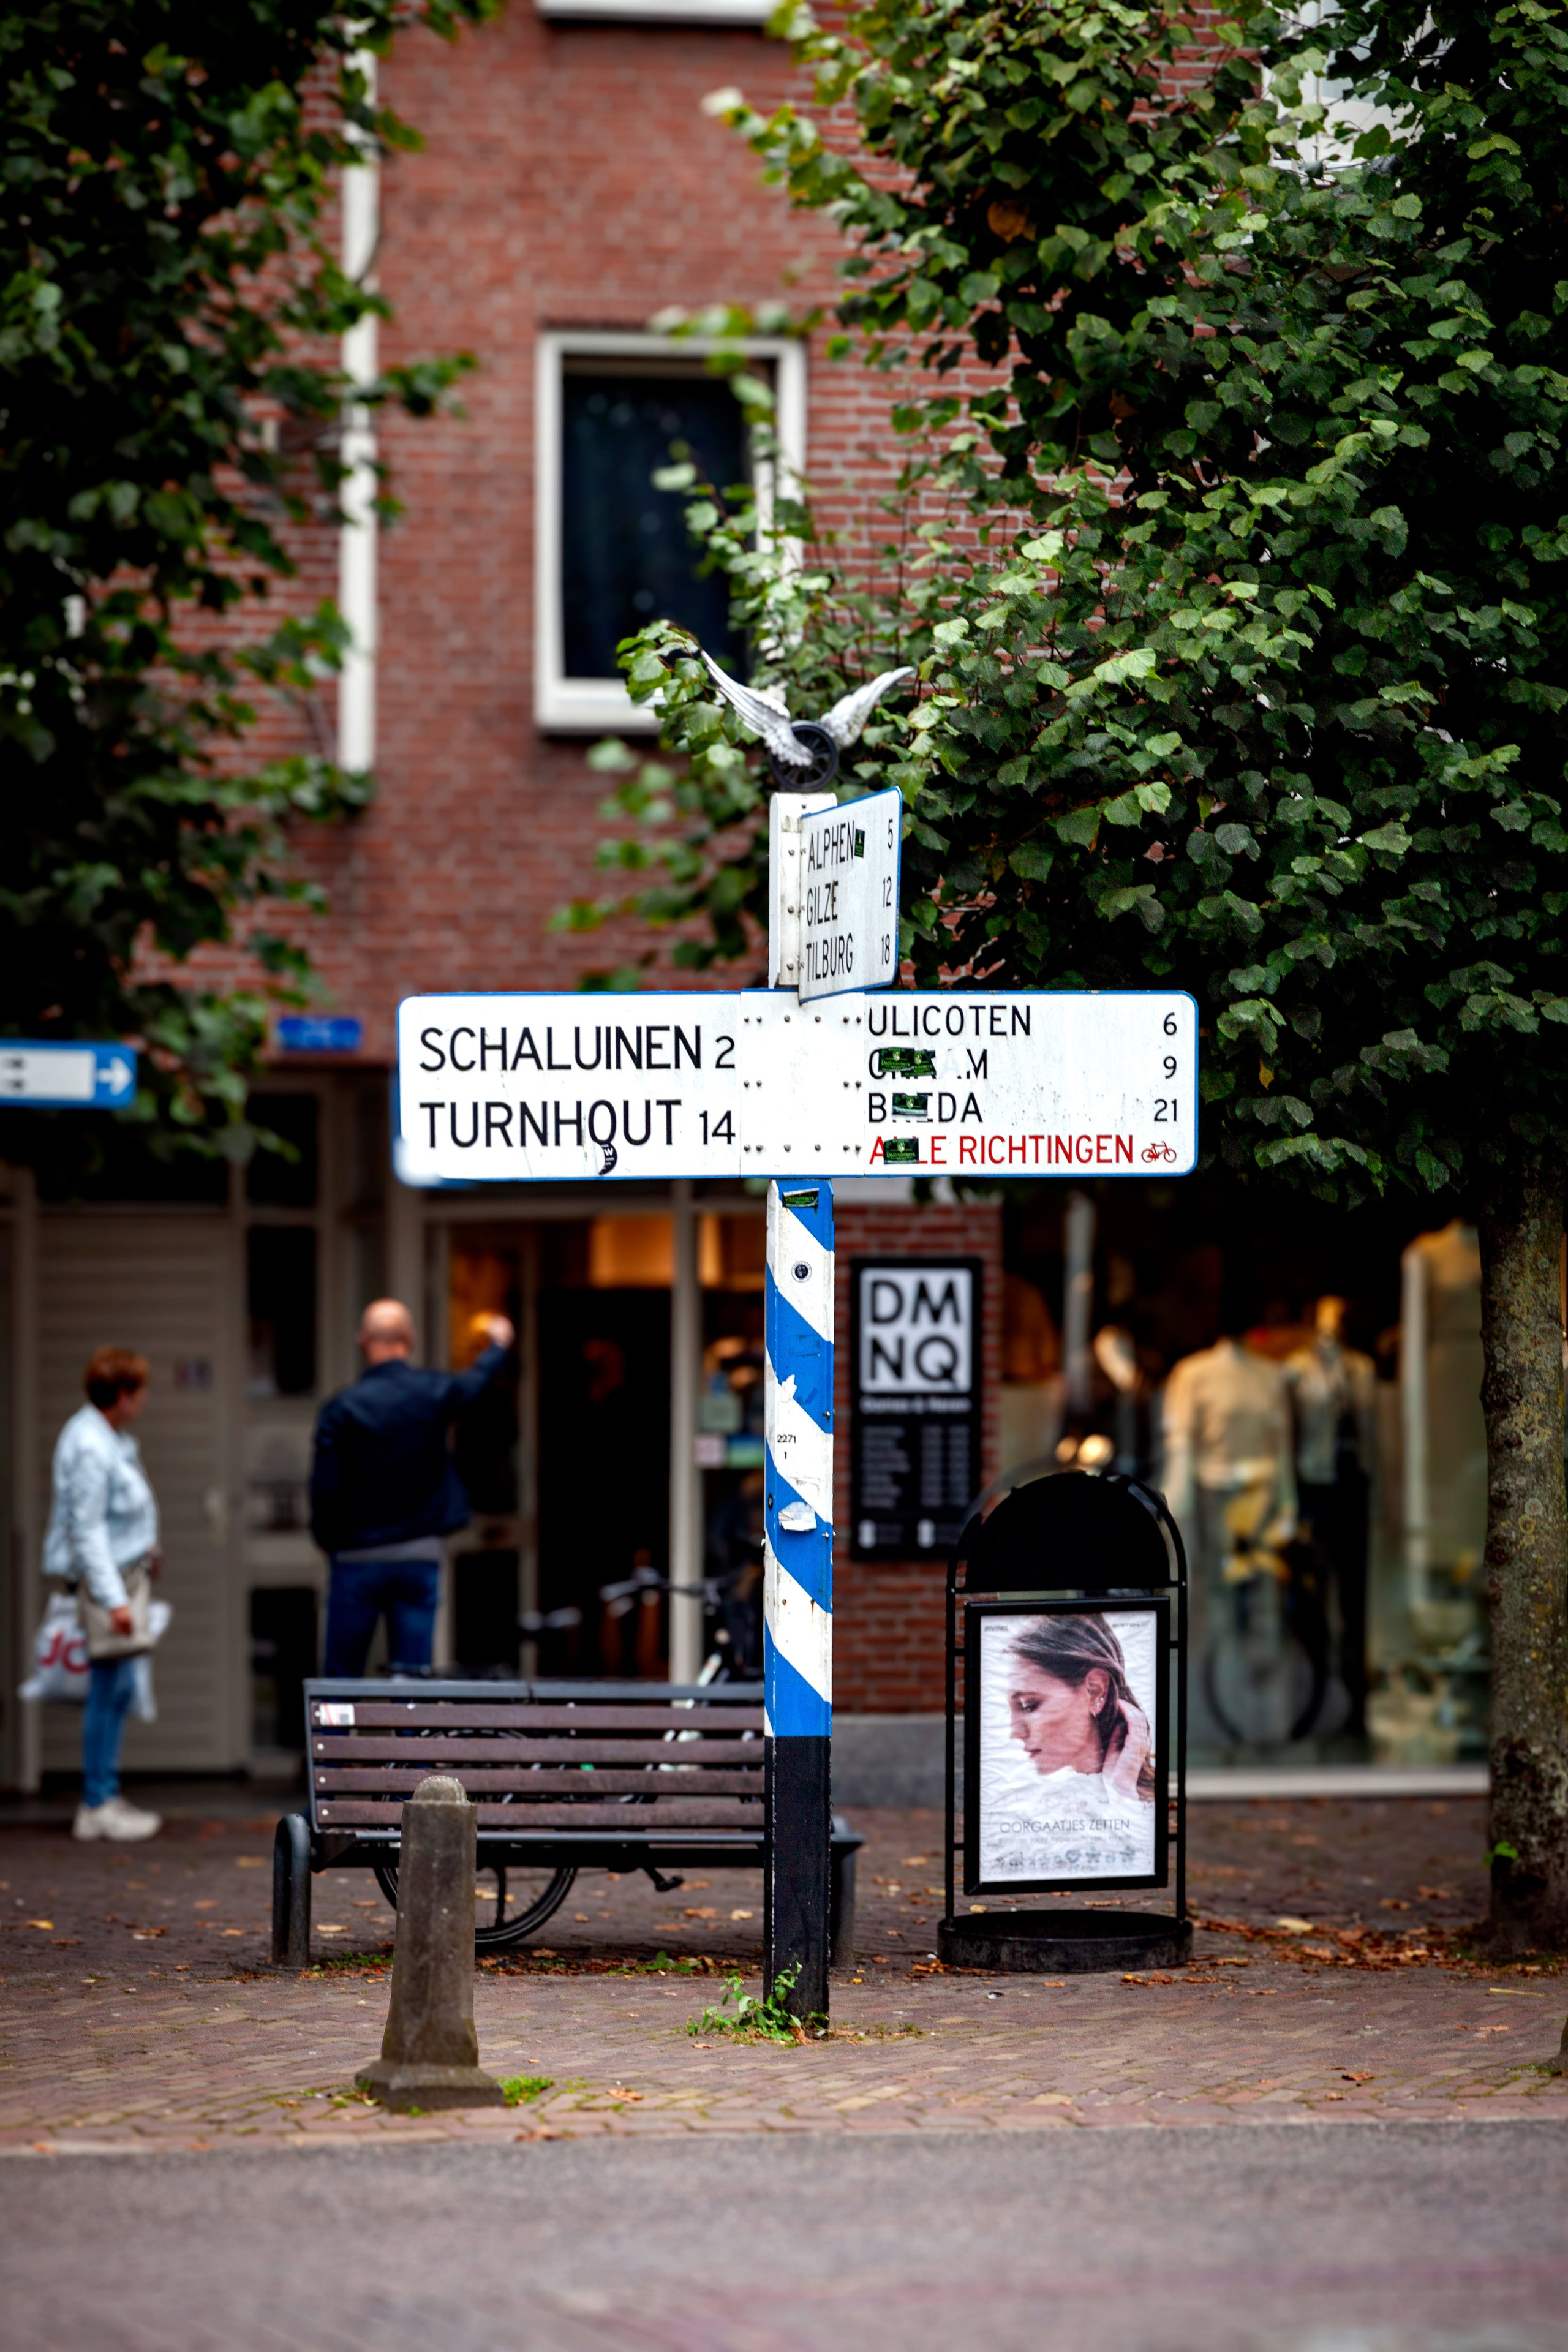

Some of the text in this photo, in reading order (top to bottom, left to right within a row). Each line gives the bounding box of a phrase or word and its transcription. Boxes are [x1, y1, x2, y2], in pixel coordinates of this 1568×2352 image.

[808, 820, 854, 872] ALPHEN
[888, 818, 893, 850] 5
[807, 876, 892, 927] GILZE 12
[806, 932, 890, 982] TILBURG 18
[869, 1005, 1177, 1036] ULICOTEN 6
[419, 1025, 736, 1072] SCHALUINEN 2
[1163, 1055, 1177, 1079] 9
[419, 1099, 736, 1148] TURNHOUT 14
[869, 1092, 984, 1123] BDA
[1153, 1098, 1177, 1122] 21
[869, 1135, 947, 1164] AE
[959, 1134, 1133, 1164] RICHTINGEN
[870, 1278, 962, 1326] DM
[870, 1334, 960, 1392] NQ
[777, 1434, 797, 1444] 2271
[999, 1820, 1085, 1833] OORGAATJES
